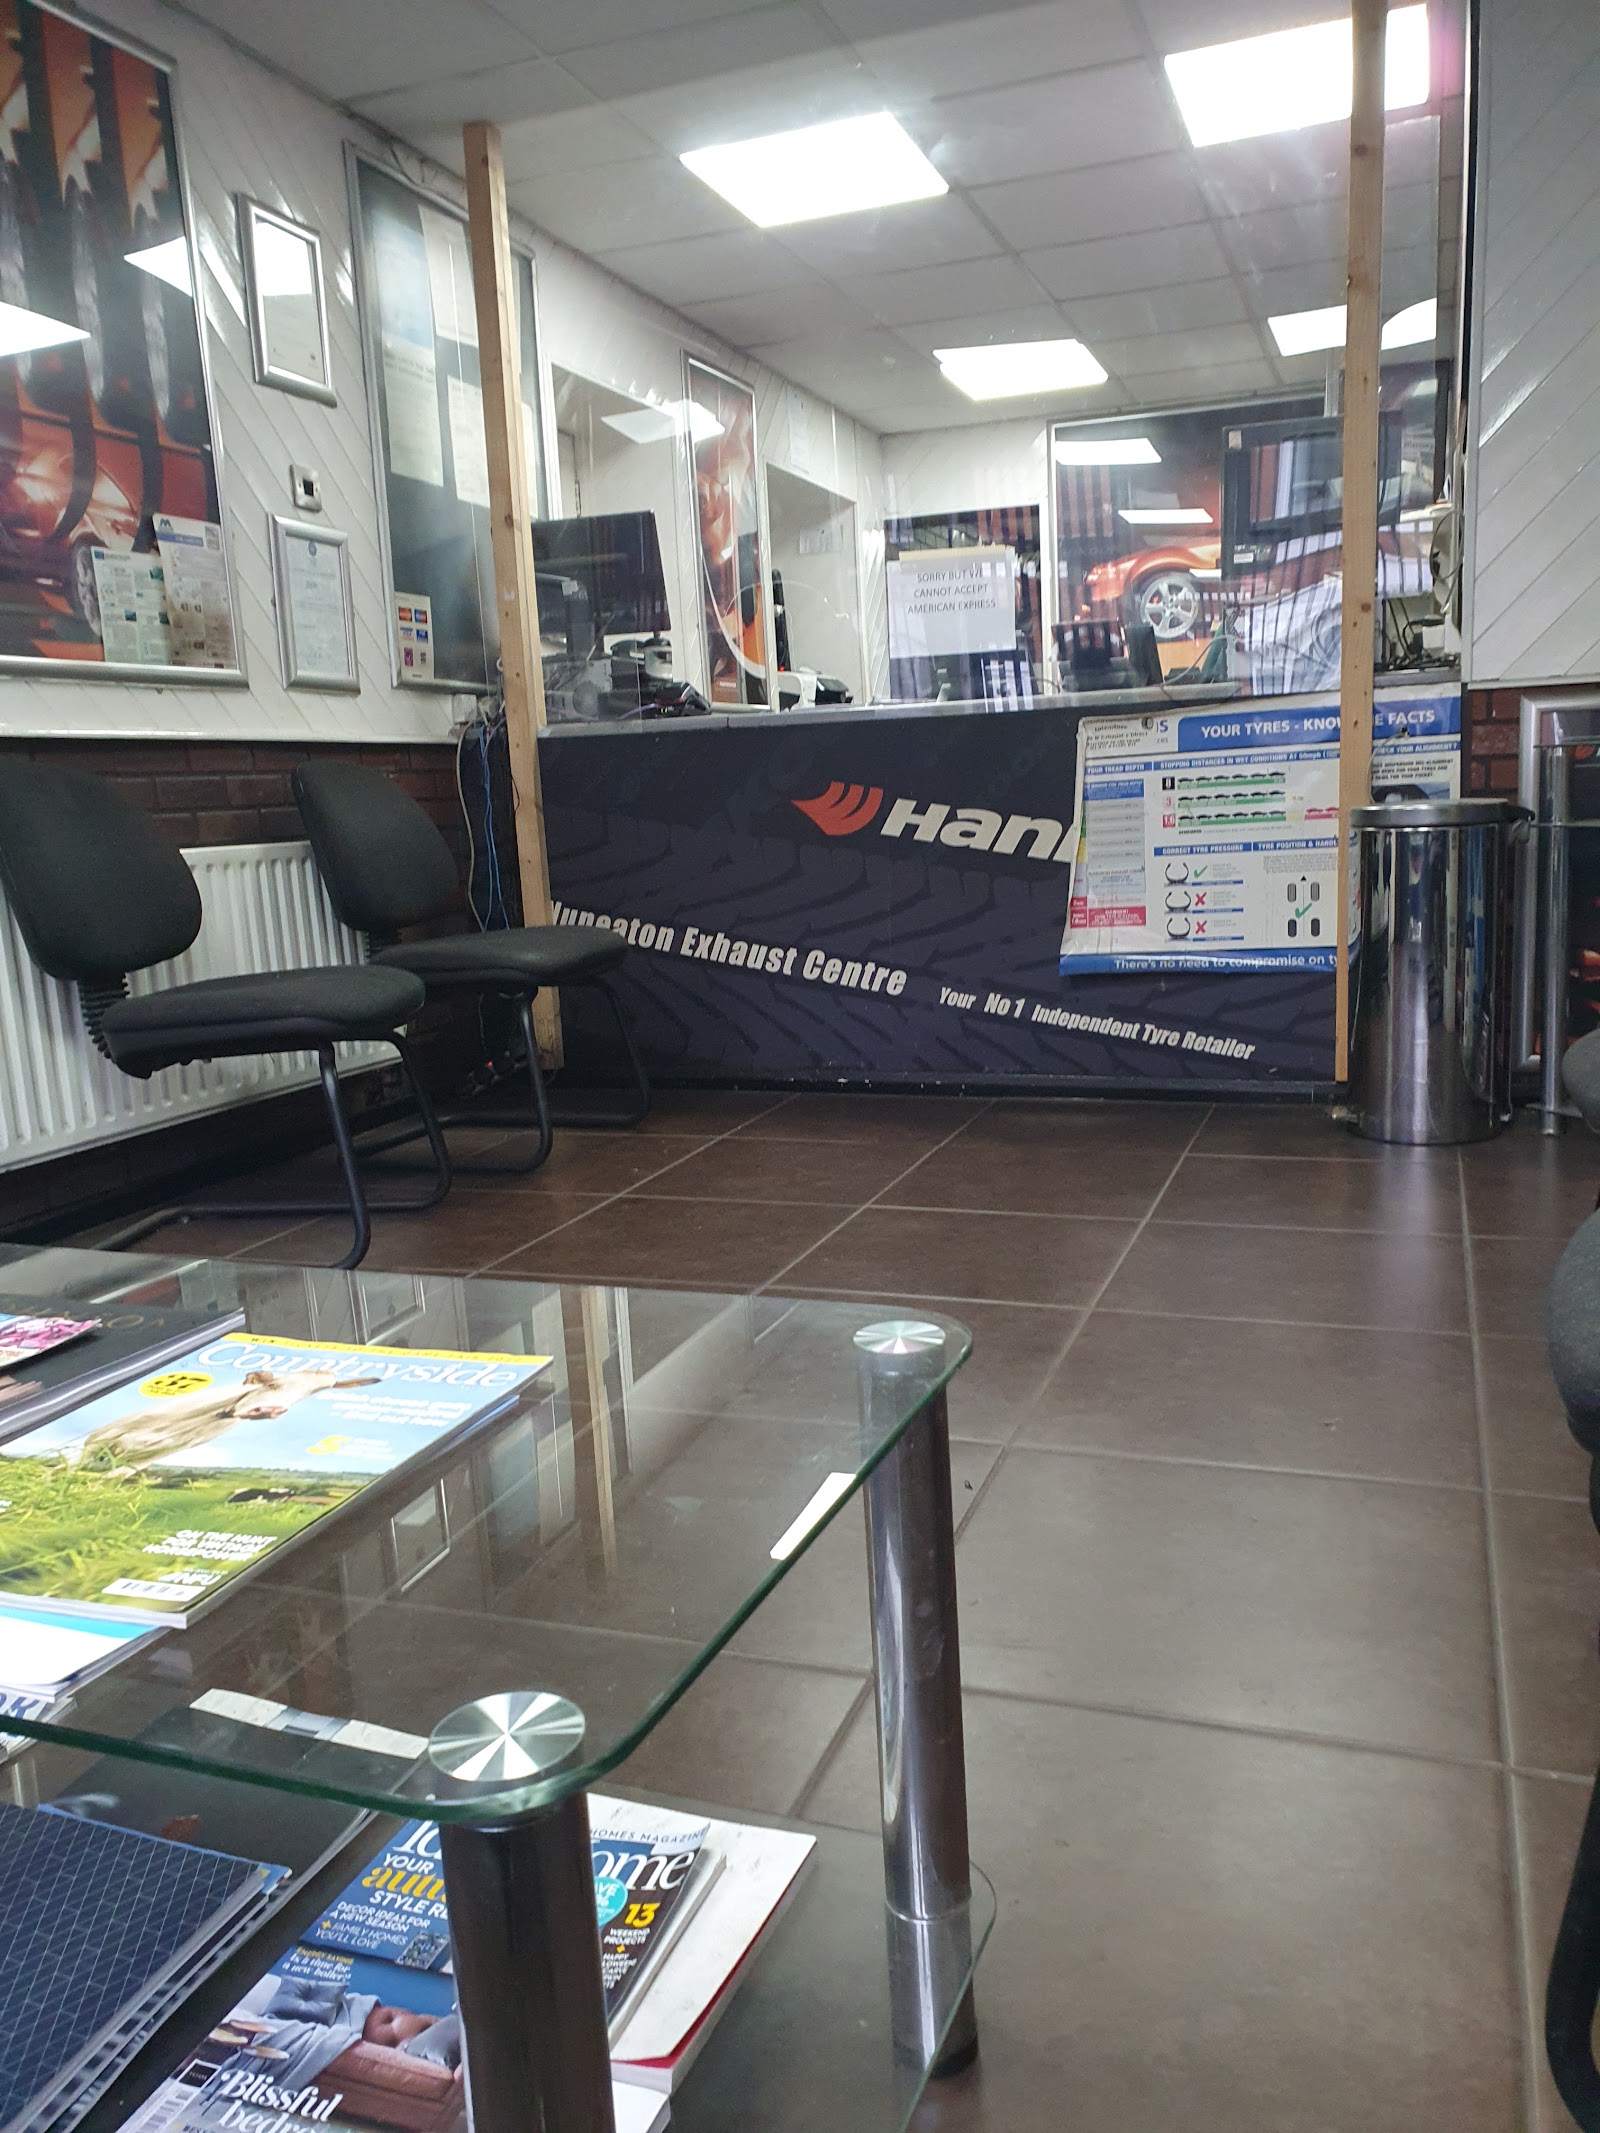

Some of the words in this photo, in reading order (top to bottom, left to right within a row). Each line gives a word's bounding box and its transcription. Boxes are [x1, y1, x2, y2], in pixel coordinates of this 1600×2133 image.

[917, 570, 946, 584] SORRY
[948, 569, 966, 581] BUT
[914, 586, 952, 599] CANNOT
[954, 583, 989, 596] ACCEPT
[907, 602, 956, 615] AMERICAN
[958, 599, 996, 612] EXPRESS
[1388, 709, 1435, 725] FACTS
[1201, 723, 1241, 739] YOUR
[1245, 720, 1290, 735] TYRES
[1303, 716, 1340, 731] KNO
[1087, 766, 1103, 774] YOUR
[1104, 765, 1124, 773] TREAD
[1125, 763, 1144, 772] DEPTH
[1160, 760, 1190, 769] STOPPING
[1191, 758, 1225, 767] DISTANCES
[1250, 753, 1288, 763] CONDITIONS
[1162, 847, 1190, 855] CORRECT
[1192, 845, 1208, 854] TYRE
[1210, 844, 1244, 853] PRESSURE
[1258, 842, 1274, 850] TYRE
[1276, 840, 1307, 849] POSITION
[679, 926, 798, 976] Exhaust
[802, 949, 908, 996] Centre
[1114, 958, 1156, 970] There's
[1160, 959, 1176, 969] no
[1179, 957, 1209, 968] need
[1213, 957, 1226, 968] to
[1229, 954, 1306, 968] compromise
[1308, 954, 1325, 966] on
[939, 987, 977, 1010] Your
[984, 992, 1011, 1016] No
[1015, 998, 1026, 1019] 1
[1031, 1003, 1141, 1040] Independent
[1142, 1023, 1180, 1047] Tyre
[1181, 1031, 1256, 1061] Retailer
[198, 1342, 519, 1387] Countryside
[203, 1531, 234, 1543] THE
[231, 1533, 277, 1547] HUNT
[382, 1852, 434, 1875] YOUR
[592, 1850, 695, 1891] ome
[370, 1890, 430, 1915] STYLE
[330, 1910, 338, 1919] A
[339, 1911, 367, 1925] NEW
[365, 1914, 410, 1933] SEASON
[337, 1901, 376, 1917] DECOR
[375, 1906, 409, 1923] IDEAS
[407, 1914, 430, 1929] FOR
[625, 1903, 660, 1928] 13
[315, 1929, 350, 1944] YOU'LL
[351, 1935, 379, 1949] LOVE
[331, 1921, 367, 1937] FAMILY
[369, 1929, 408, 1946] HOMES
[603, 1935, 646, 1945] PROJECTS
[610, 1927, 650, 1937] WEEKEND
[291, 1965, 311, 1974] new
[310, 1958, 334, 1969] time
[333, 1962, 351, 1973] for
[221, 2067, 343, 2122] Blissful
